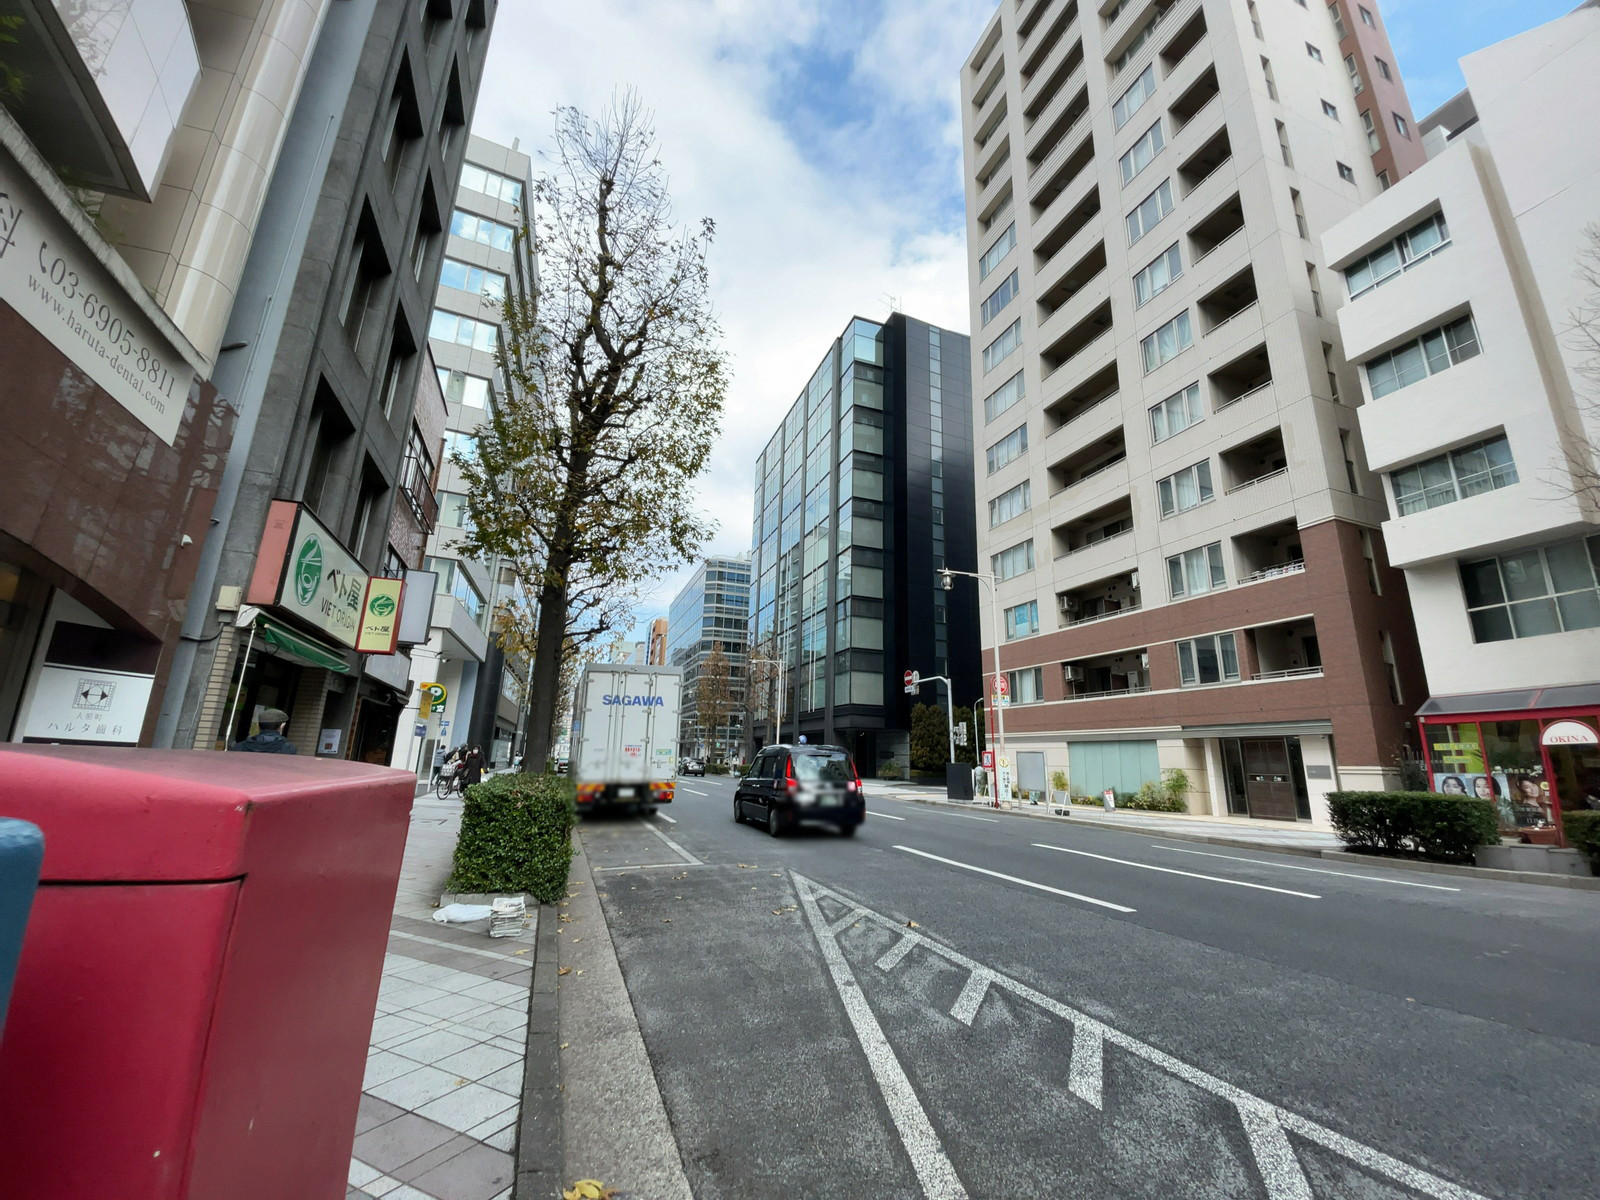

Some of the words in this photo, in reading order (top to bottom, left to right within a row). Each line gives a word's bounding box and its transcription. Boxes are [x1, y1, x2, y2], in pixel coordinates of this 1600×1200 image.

[50, 258, 175, 399] 03-6905-8811
[28, 274, 166, 415] www.haruta-dental.com
[321, 596, 337, 619] VIET
[602, 694, 664, 707] SAGAWA
[47, 722, 123, 736] ハルタ歯科
[1550, 735, 1589, 743] OKINA
